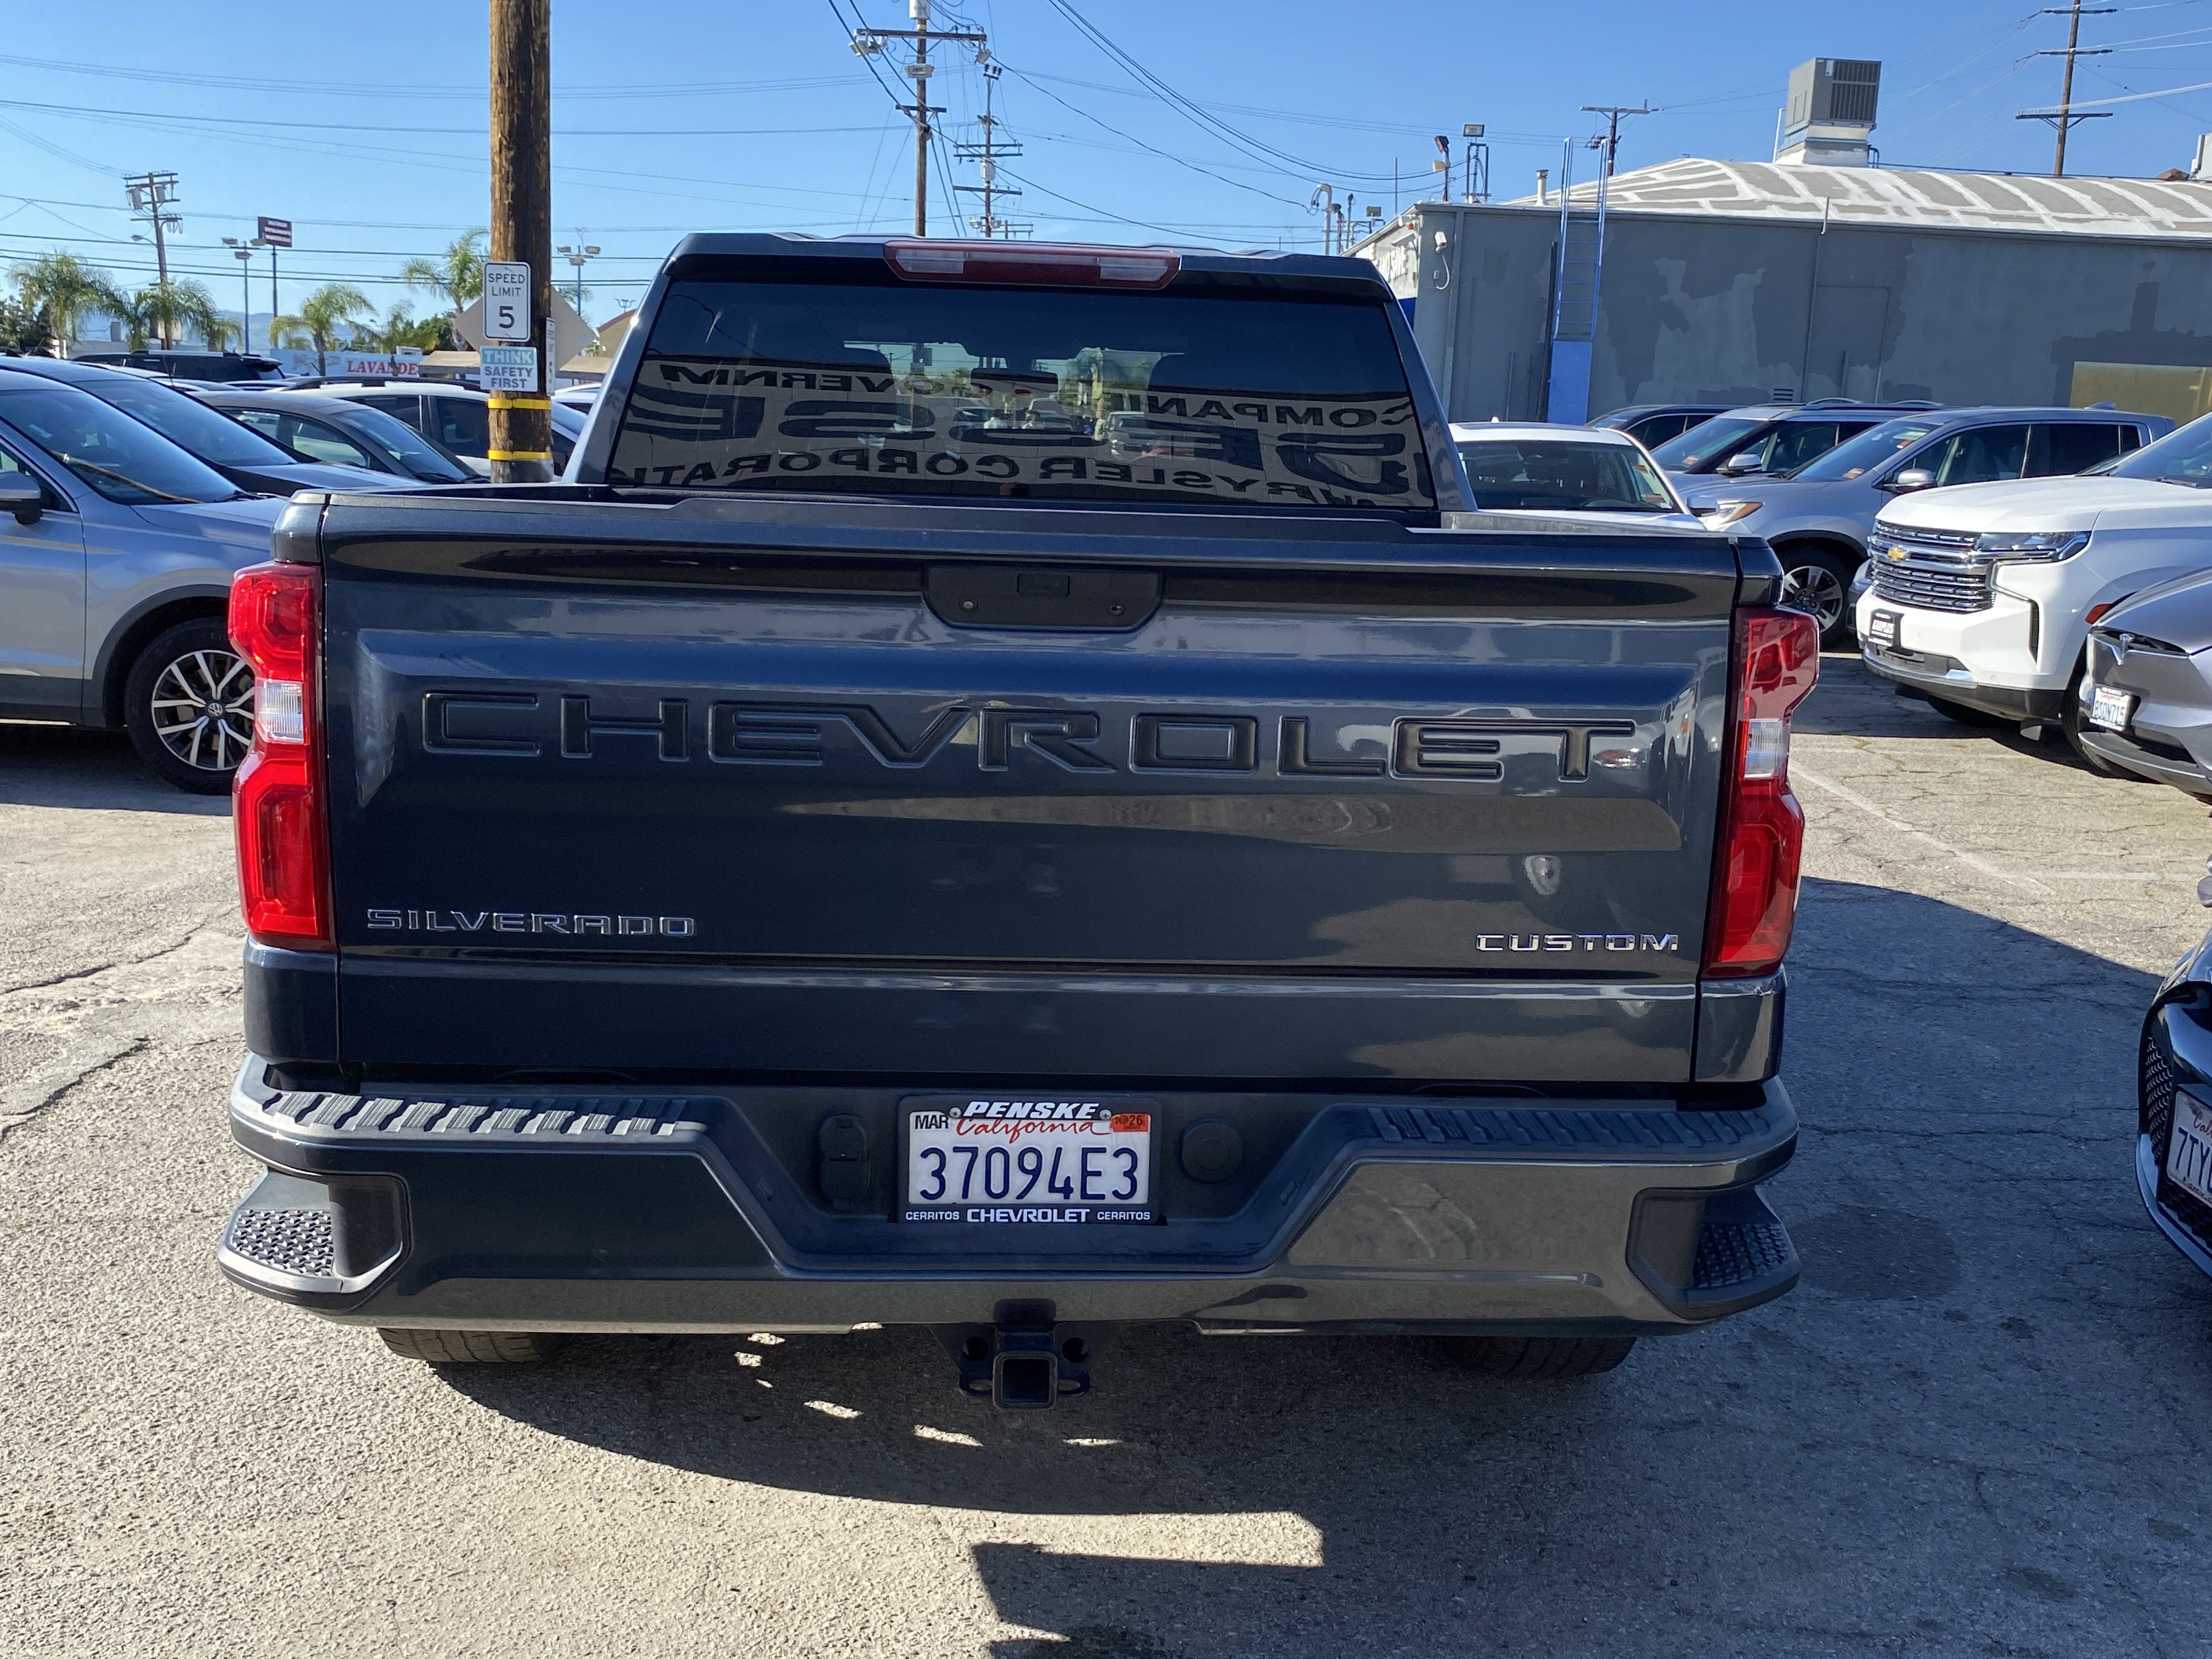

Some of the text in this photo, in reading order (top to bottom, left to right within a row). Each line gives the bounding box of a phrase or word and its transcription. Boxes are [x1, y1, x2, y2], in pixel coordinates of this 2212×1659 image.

[488, 273, 525, 284] SPEED
[492, 287, 521, 297] LIMIT
[499, 306, 515, 329] 5
[484, 349, 533, 365] THINK
[484, 366, 533, 377] SAFETY
[491, 378, 527, 388] FIRST
[422, 691, 1637, 783] CHEVROLET
[367, 909, 695, 936] SILVERADO
[1476, 934, 1678, 951] CUSTOM
[963, 1101, 1099, 1119] PENSKE
[915, 1115, 950, 1130] MAR
[1129, 1115, 1143, 1126] 26
[956, 1118, 1111, 1144] California
[919, 1146, 1138, 1200] 37094E3
[905, 1209, 1150, 1222] CERRITOS CHEVROLET CERRITOS
